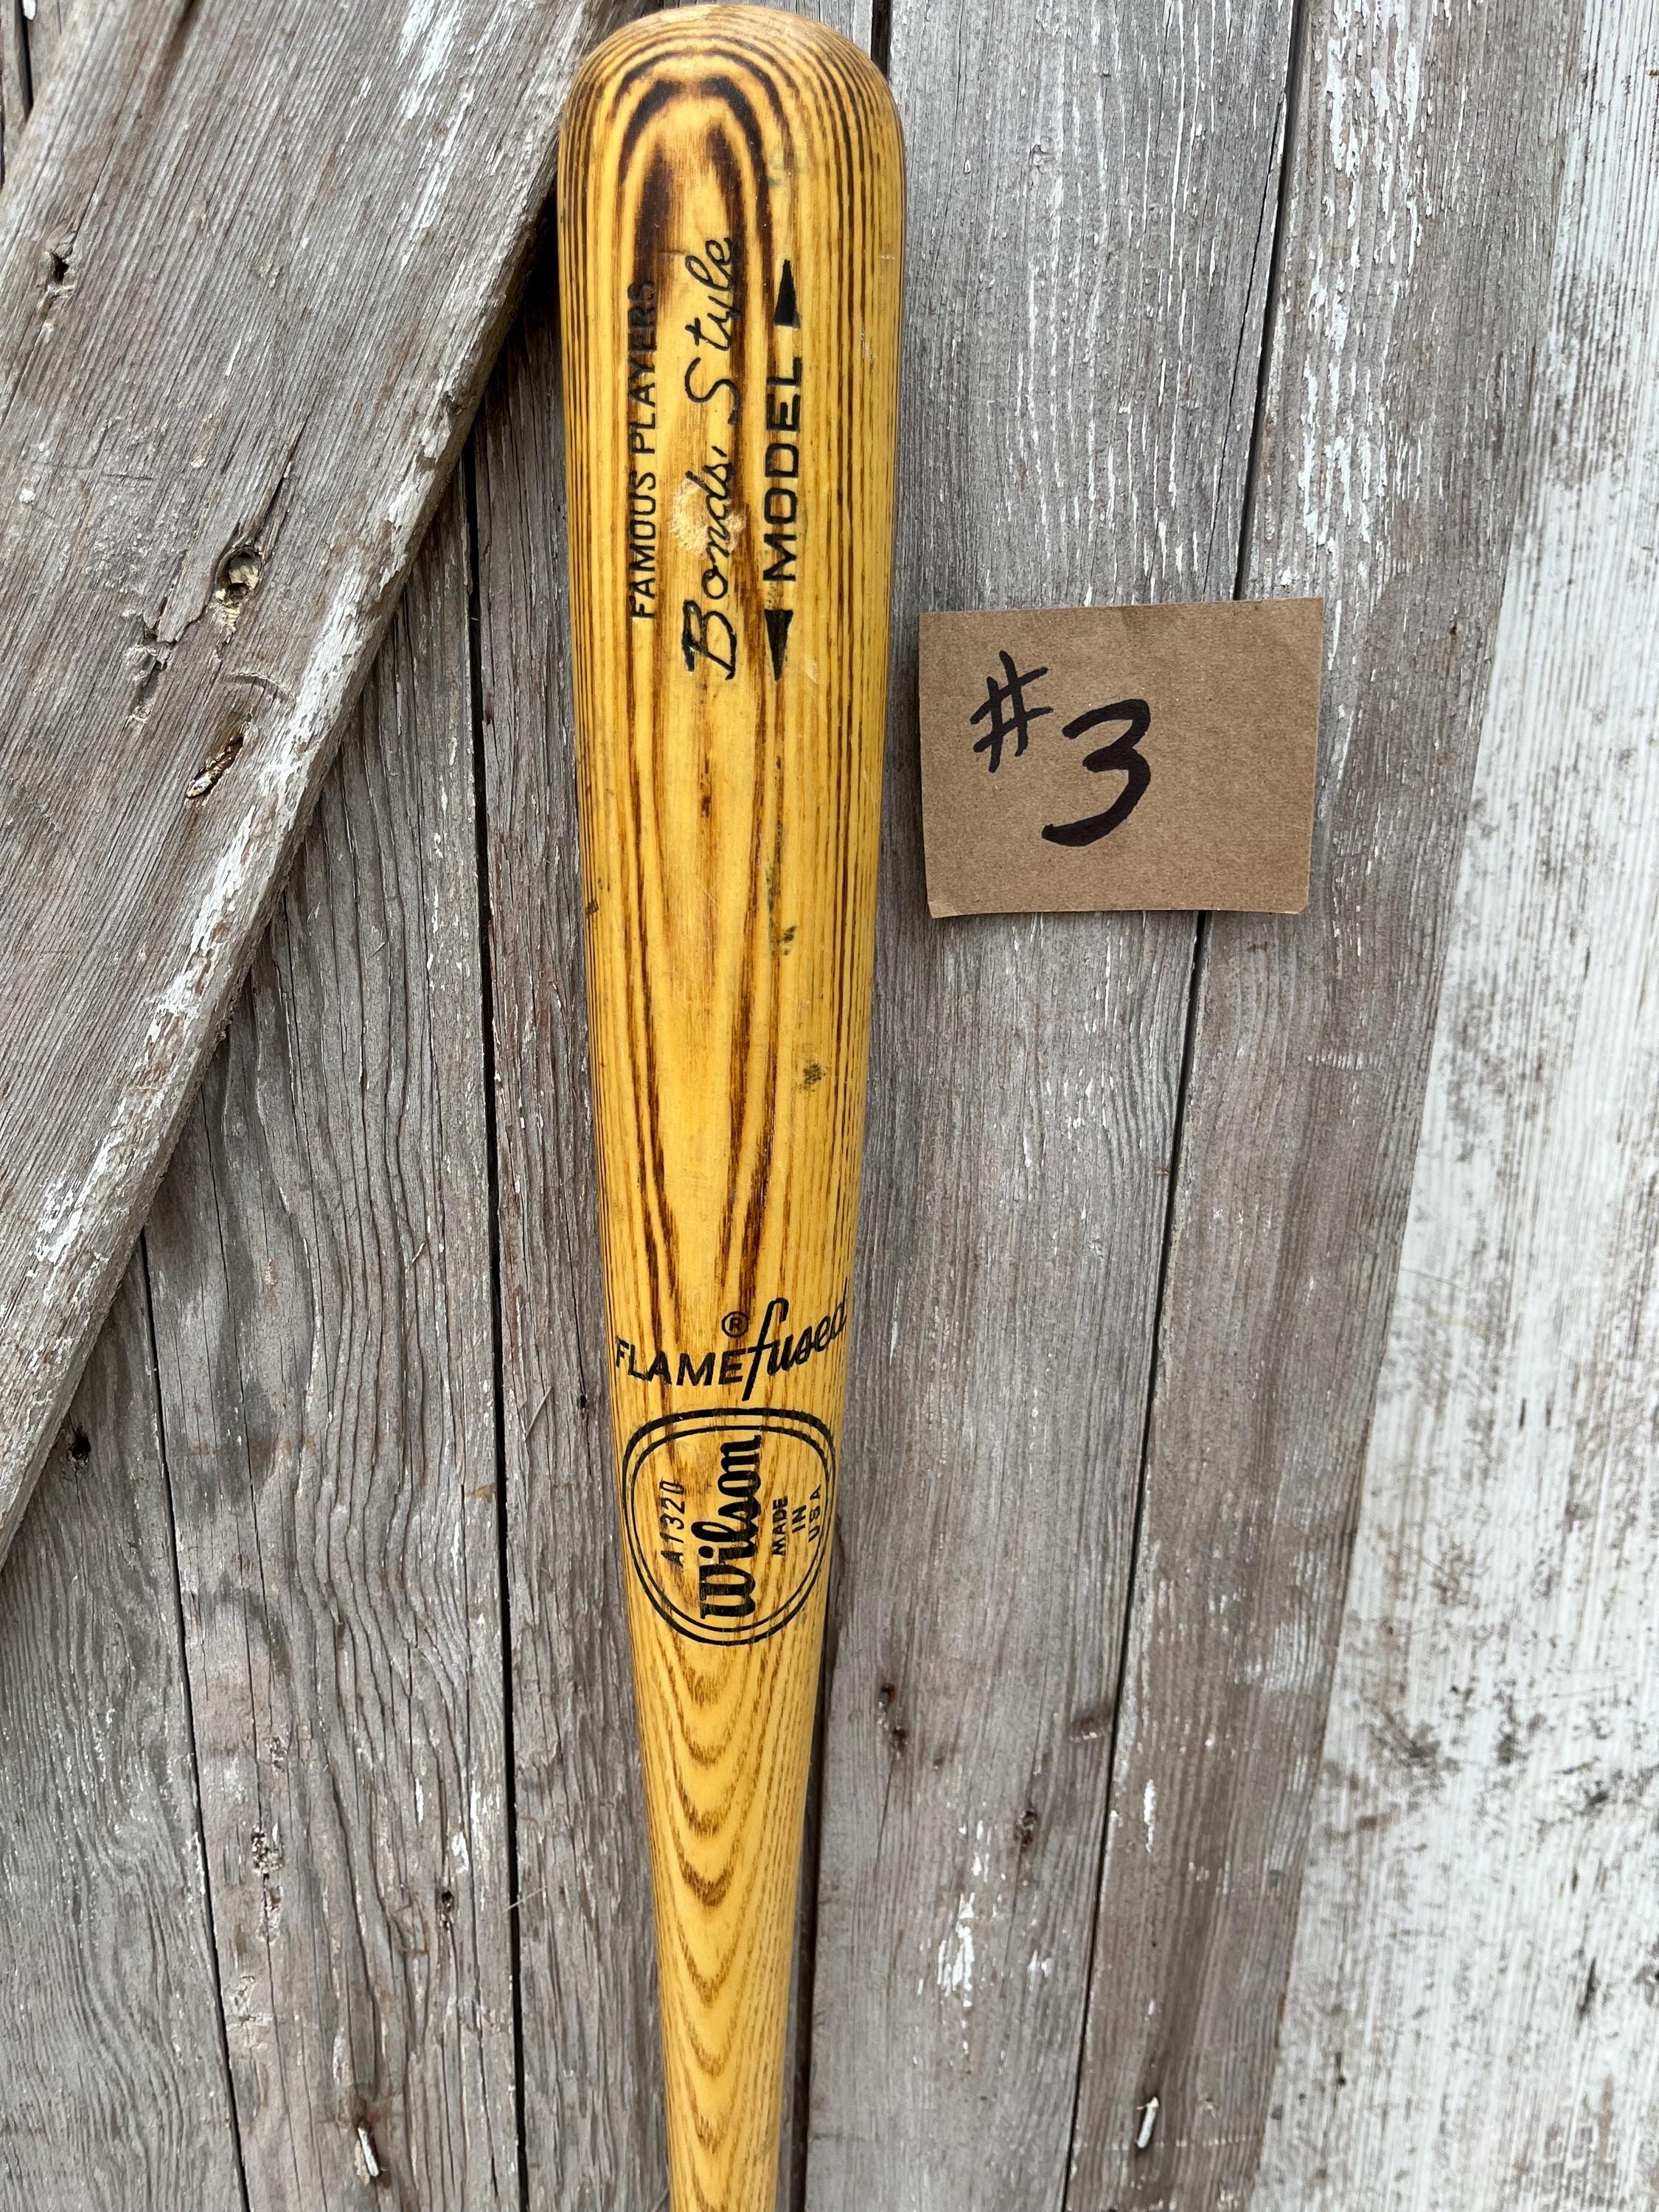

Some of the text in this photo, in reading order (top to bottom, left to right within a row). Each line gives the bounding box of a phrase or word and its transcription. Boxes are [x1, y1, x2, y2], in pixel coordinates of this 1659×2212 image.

[684, 237, 740, 425] Style
[627, 280, 657, 619] FAMOUS PLAYERS
[762, 357, 802, 582] MODEL
[659, 1477, 685, 1569] A1320
[690, 1434, 762, 1619] Wilson
[771, 1495, 788, 1556] MADE
[791, 1504, 807, 1534] IN
[807, 1484, 822, 1543] USA
